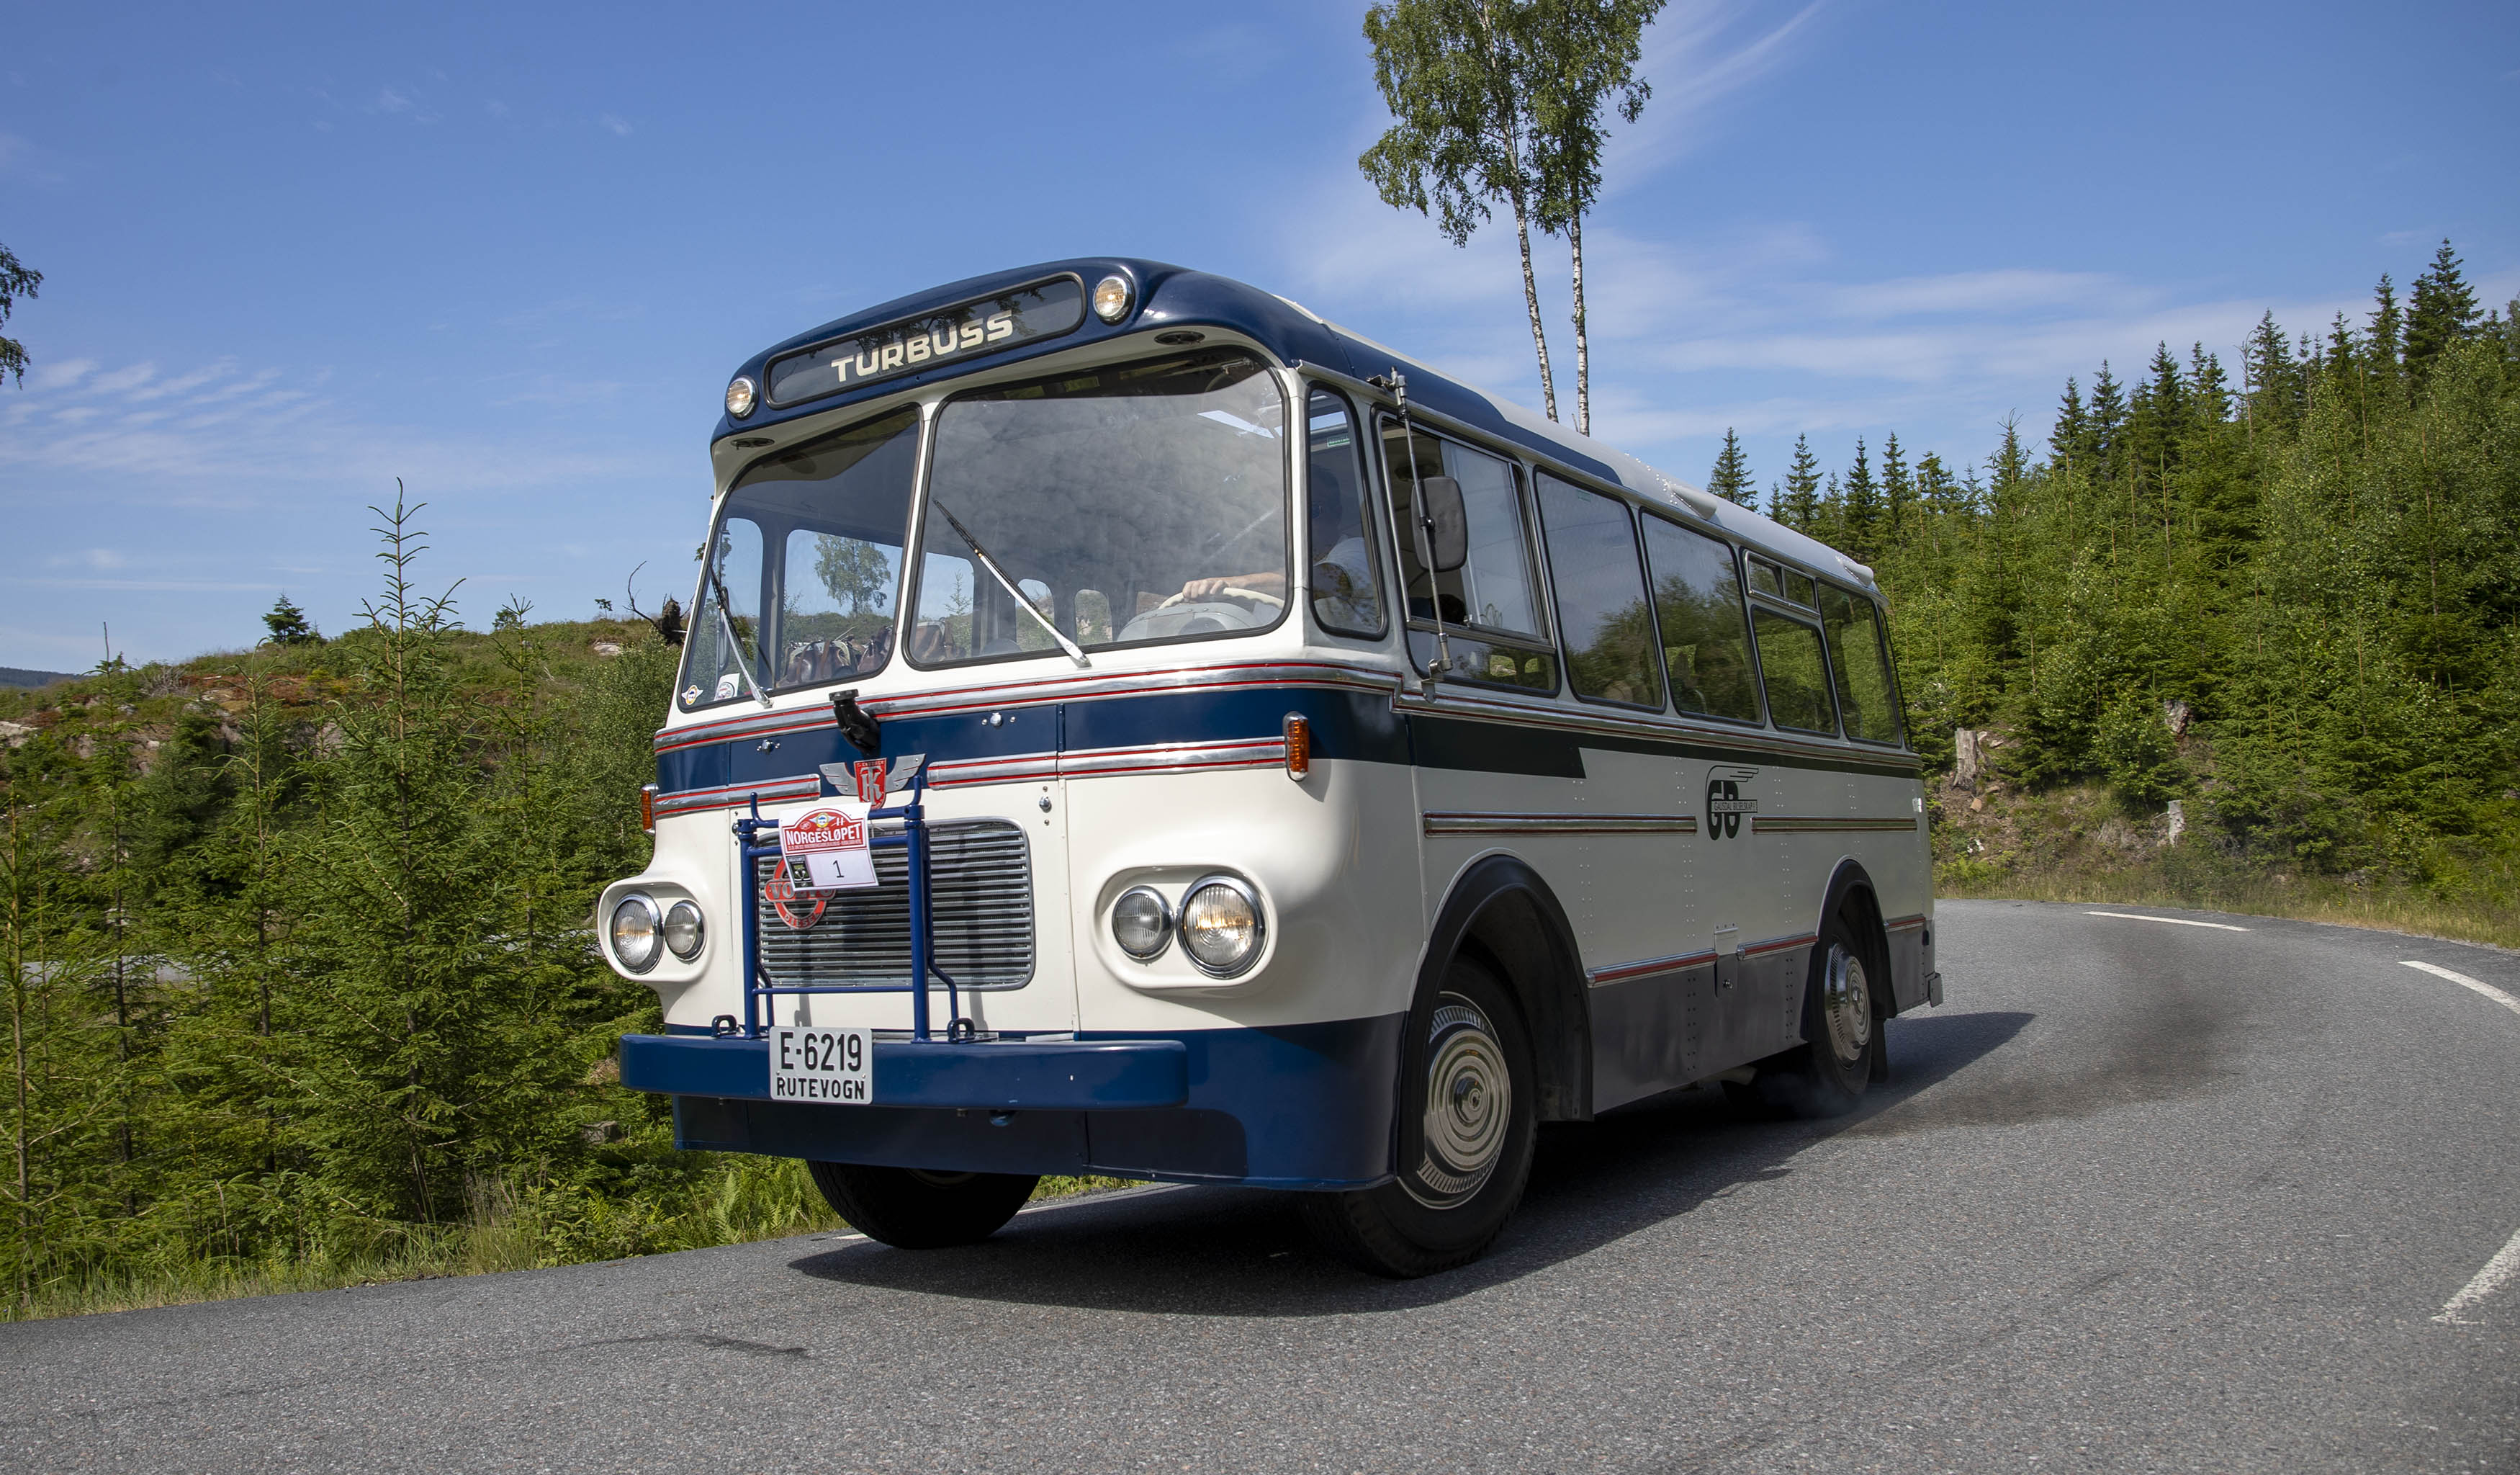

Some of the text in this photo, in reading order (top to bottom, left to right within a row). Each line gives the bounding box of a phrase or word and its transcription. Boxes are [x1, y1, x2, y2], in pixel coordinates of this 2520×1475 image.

[831, 310, 1014, 382] TURBUSS
[786, 822, 861, 846] NORGESLØPET
[832, 860, 845, 878] 1
[784, 913, 819, 927] DIESEL
[780, 1031, 862, 1072] E-6219
[777, 1077, 864, 1100] RUTEVOGN
